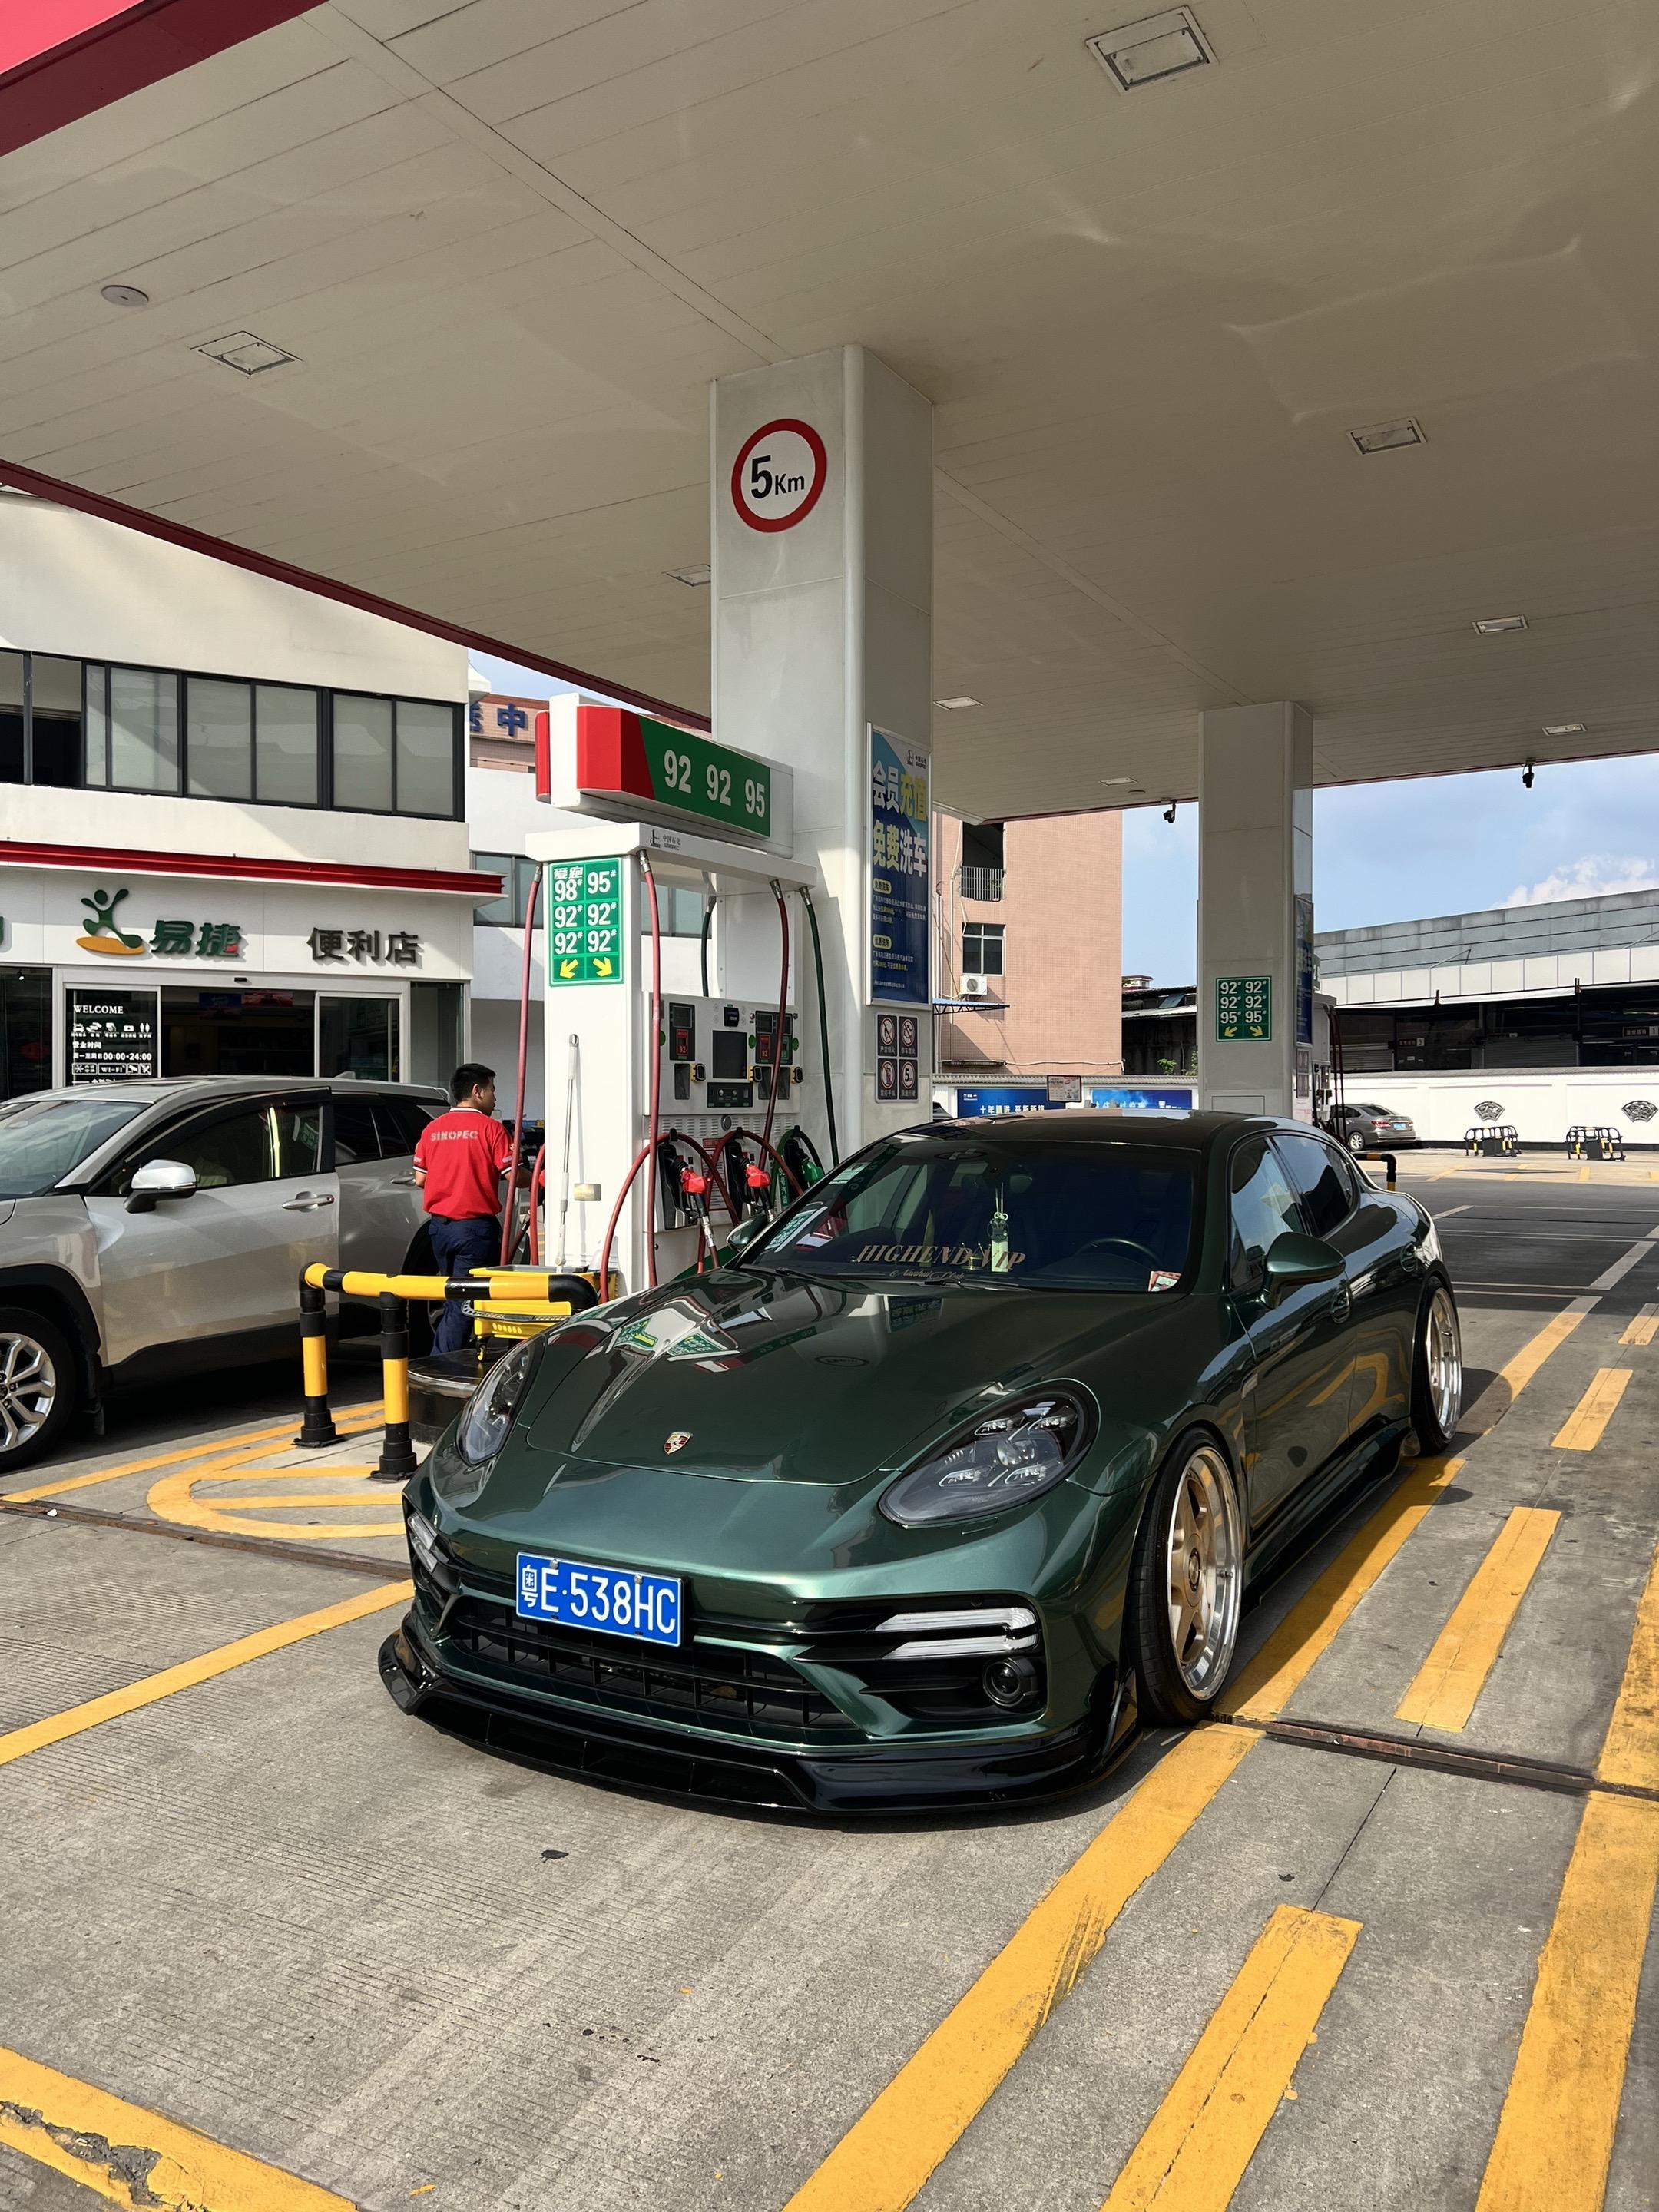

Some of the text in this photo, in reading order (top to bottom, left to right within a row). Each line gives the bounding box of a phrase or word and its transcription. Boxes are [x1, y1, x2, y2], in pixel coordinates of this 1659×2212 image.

[751, 455, 805, 499] 5Km
[664, 750, 765, 817] 92 92 95
[873, 760, 927, 822] 会员充值
[873, 820, 927, 877] 免费洗车
[151, 919, 241, 957] 易捷
[306, 927, 420, 964] 便利店
[74, 1005, 124, 1014] WELCOME
[431, 1130, 478, 1141] SINOPEC
[856, 1245, 1027, 1270] HIGHEND VIP
[520, 1564, 676, 1634] 粤E·538HC
